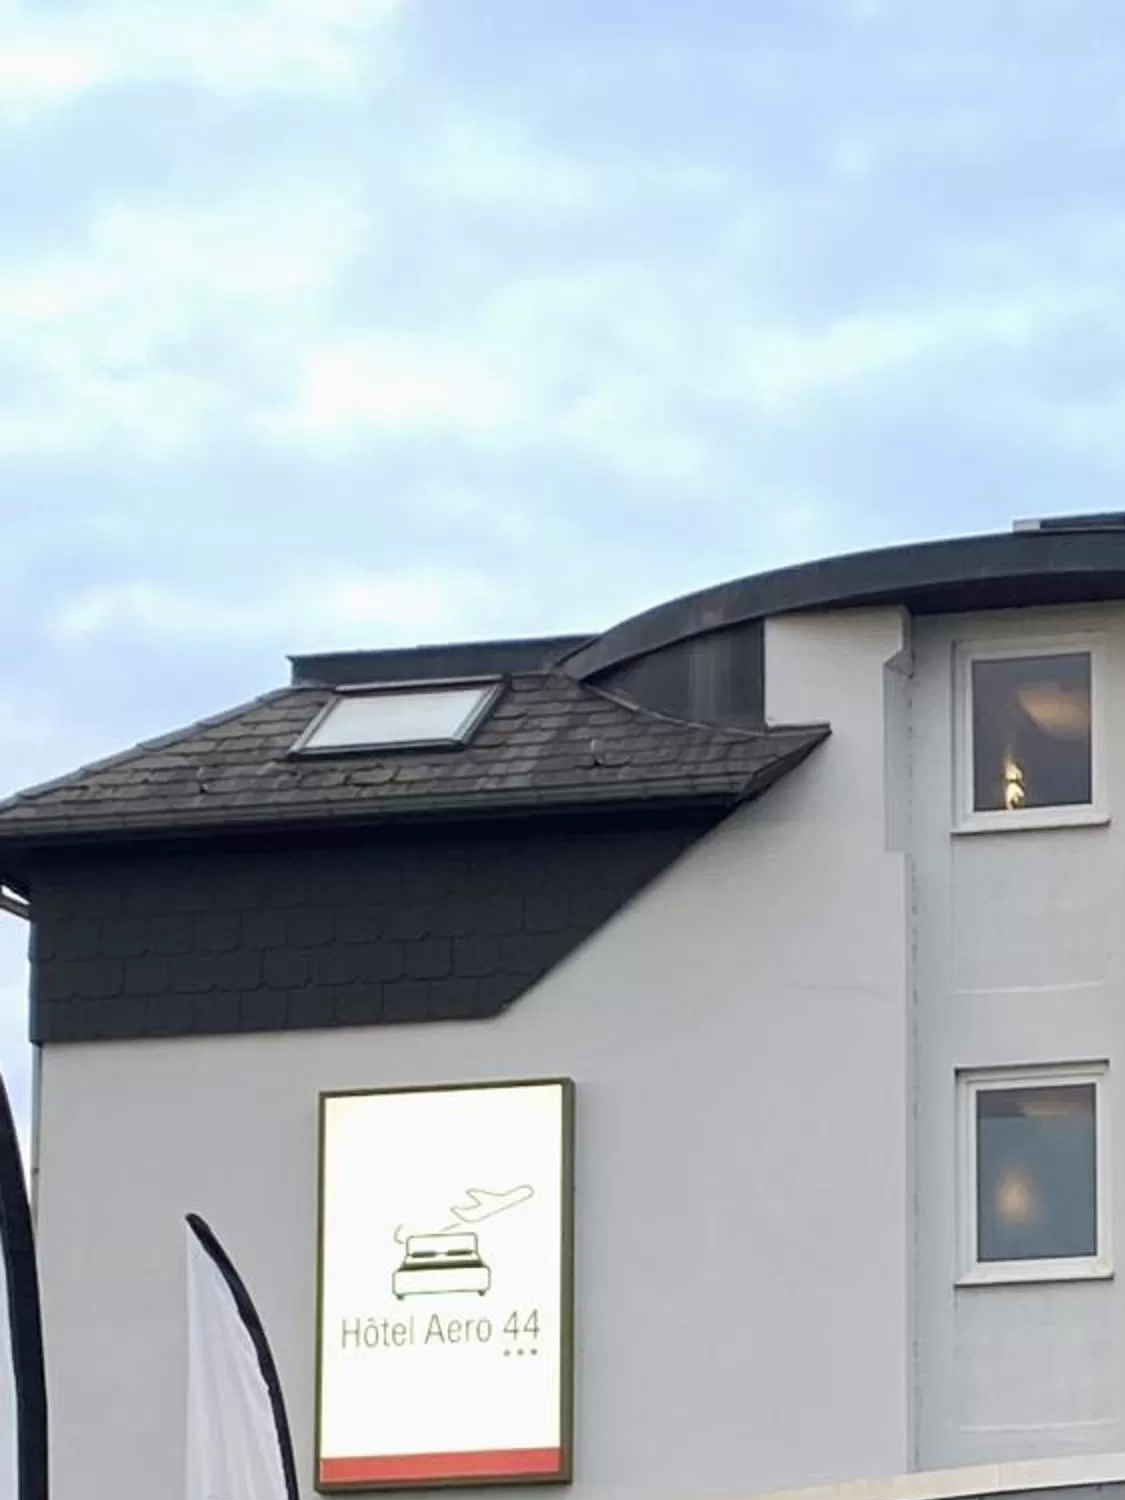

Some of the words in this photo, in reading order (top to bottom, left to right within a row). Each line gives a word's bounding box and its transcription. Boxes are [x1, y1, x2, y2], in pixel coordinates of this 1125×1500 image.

[341, 1317, 415, 1349] Hôtel
[424, 1312, 493, 1346] Aero
[503, 1309, 540, 1341] 44
